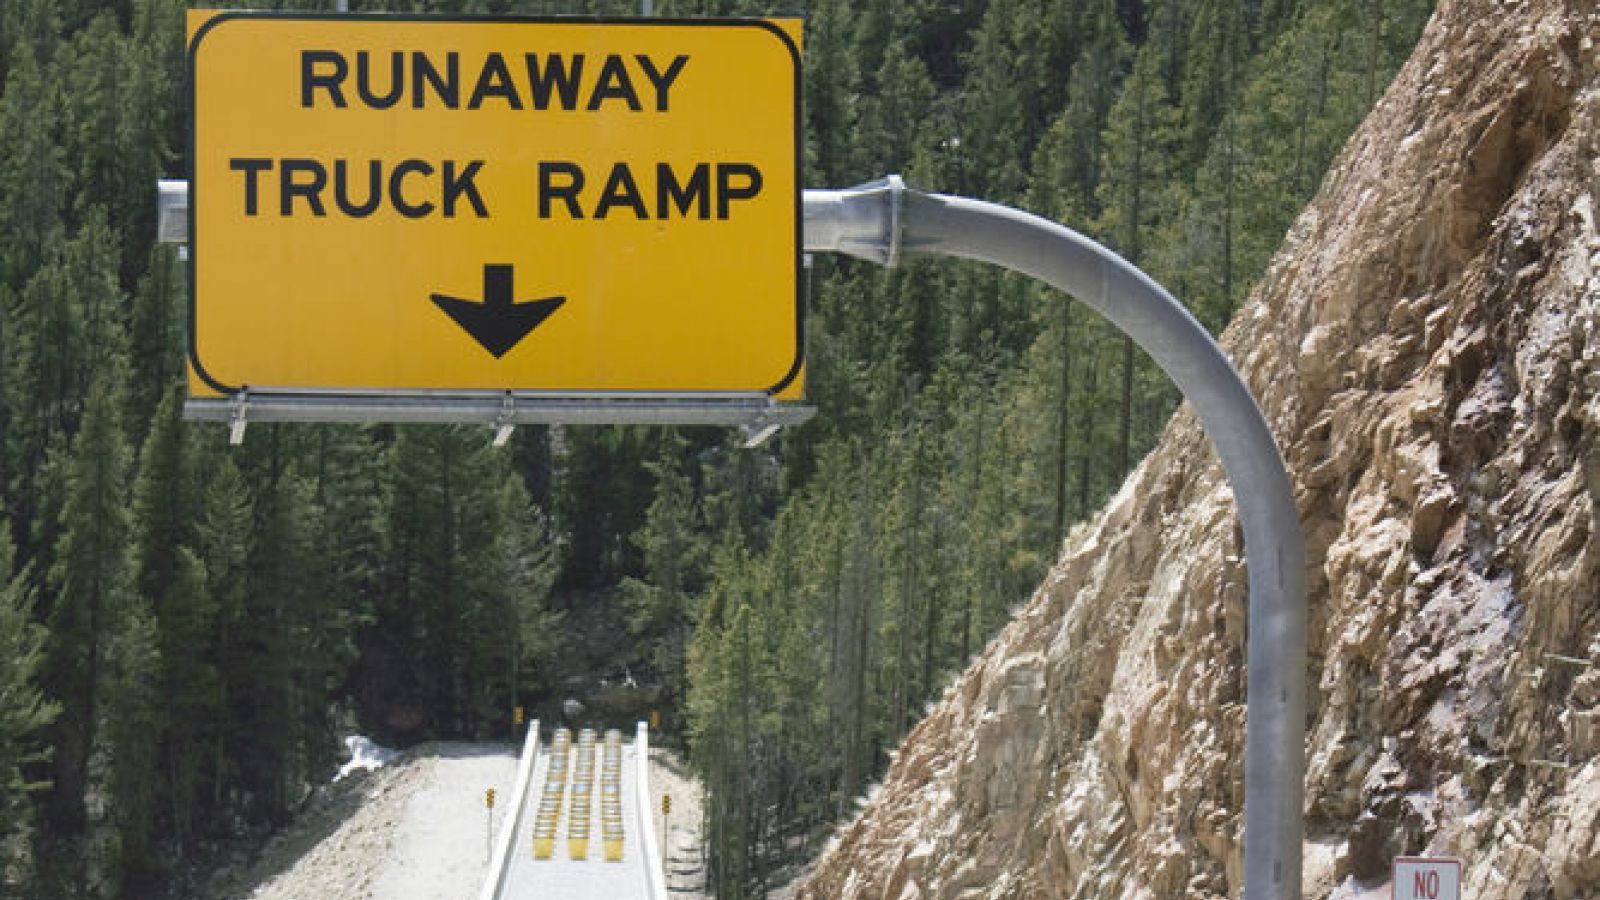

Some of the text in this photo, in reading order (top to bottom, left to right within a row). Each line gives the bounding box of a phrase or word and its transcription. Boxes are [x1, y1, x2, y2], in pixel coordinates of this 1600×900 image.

[302, 50, 688, 112] RUNAWAY
[230, 159, 763, 220] TRUCK RAMP
[1414, 869, 1439, 899] NO
